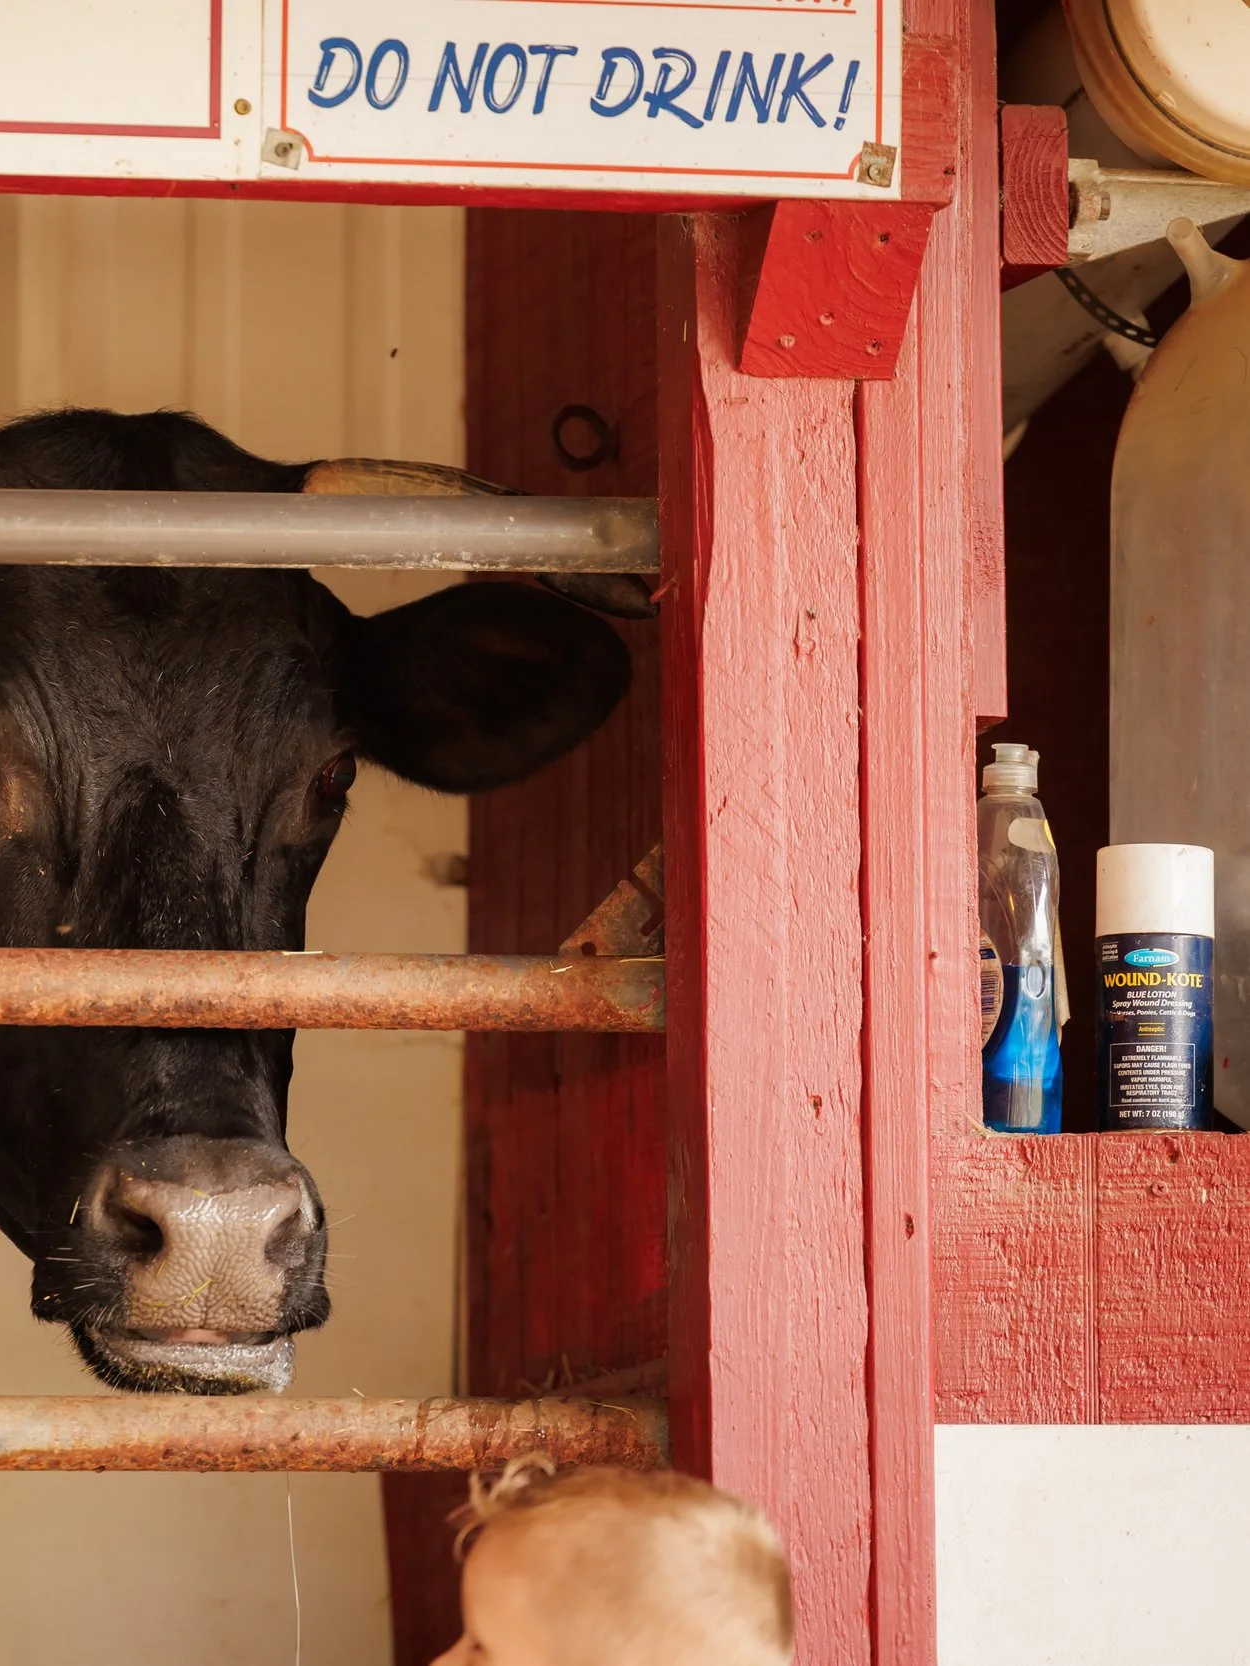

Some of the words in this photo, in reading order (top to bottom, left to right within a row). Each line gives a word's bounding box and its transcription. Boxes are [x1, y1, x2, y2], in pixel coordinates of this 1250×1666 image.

[308, 37, 410, 110] DO
[428, 41, 578, 115] NOT
[590, 46, 861, 131] DRINK!
[1133, 954, 1170, 963] Farnam
[1104, 972, 1203, 988] WOUND-KOTE
[1127, 991, 1146, 999] BLUE
[1147, 990, 1177, 999] LOTION
[1112, 1000, 1131, 1009] Spray
[1132, 999, 1160, 1007] Wound
[1161, 1000, 1193, 1009] Dressing
[1136, 1045, 1167, 1053] DANGER!
[1119, 1110, 1131, 1118] NET
[1132, 1110, 1145, 1118] WT:
[1146, 1110, 1150, 1118] 7
[1151, 1110, 1161, 1118] OZ
[1162, 1110, 1177, 1118] (198
